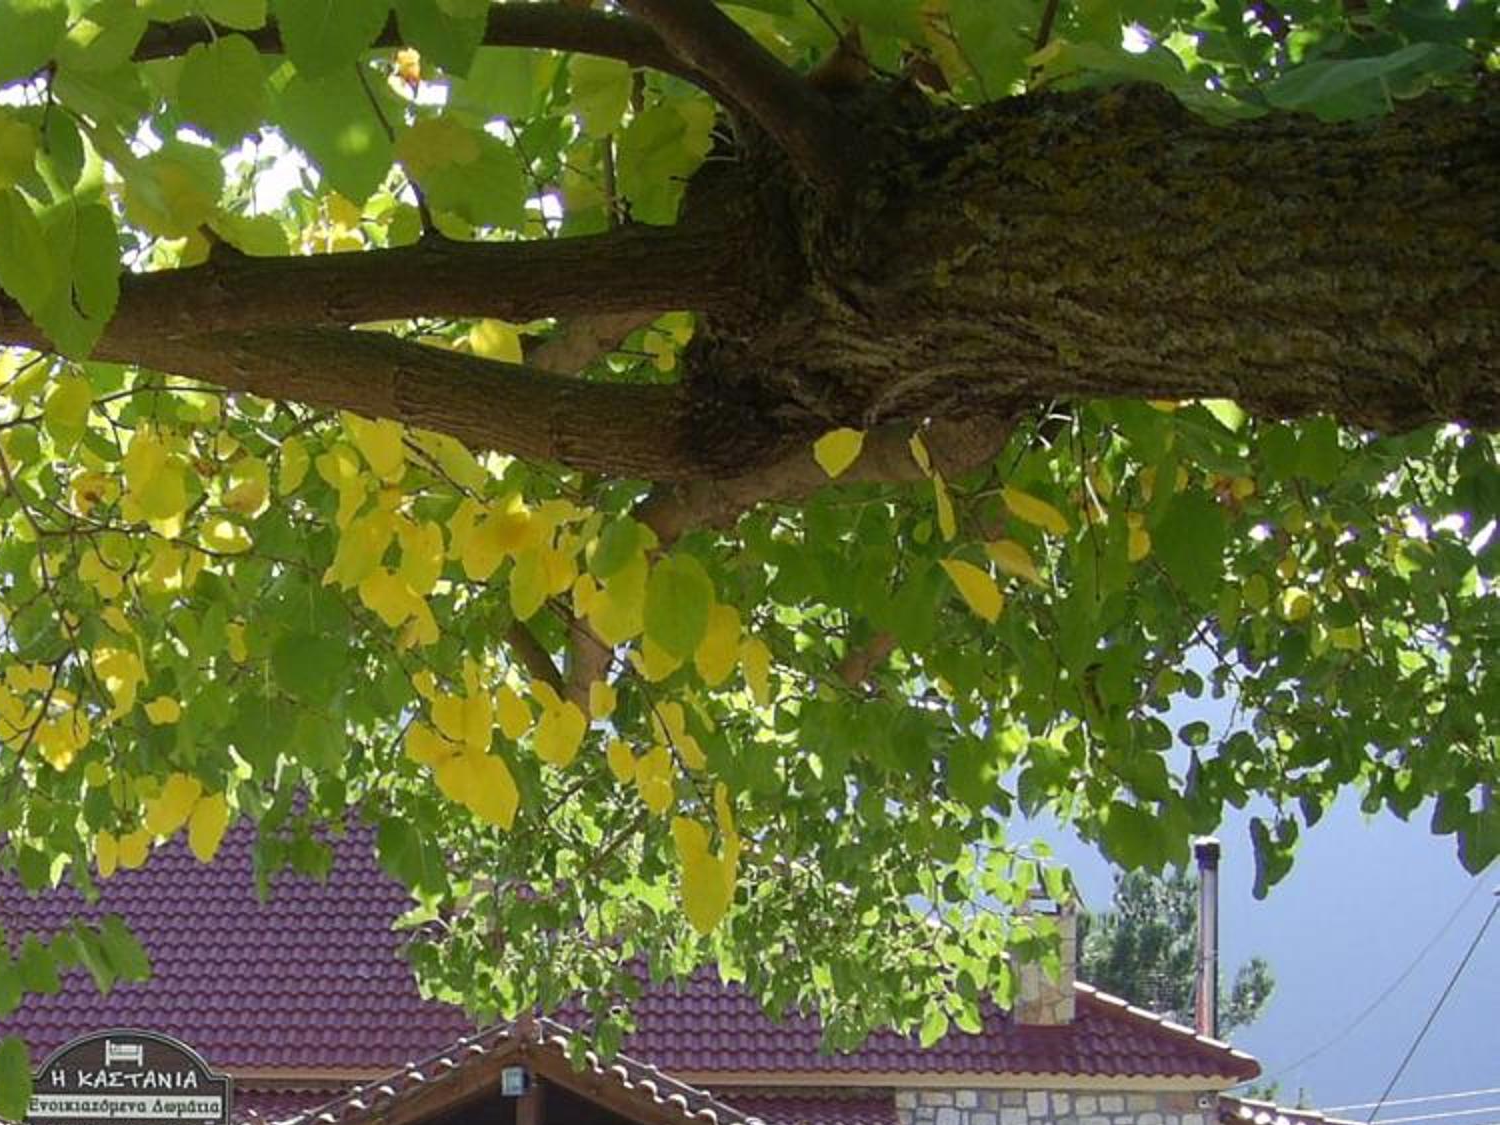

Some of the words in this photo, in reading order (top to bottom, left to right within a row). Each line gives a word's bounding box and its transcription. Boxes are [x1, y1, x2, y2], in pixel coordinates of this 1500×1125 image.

[51, 1069, 65, 1087] Η
[77, 1069, 198, 1089] ΚΑΣΤΑΝΙΑ
[29, 1098, 147, 1116] Ενοικιαζόμενα
[152, 1098, 220, 1116] Δωμάτια
